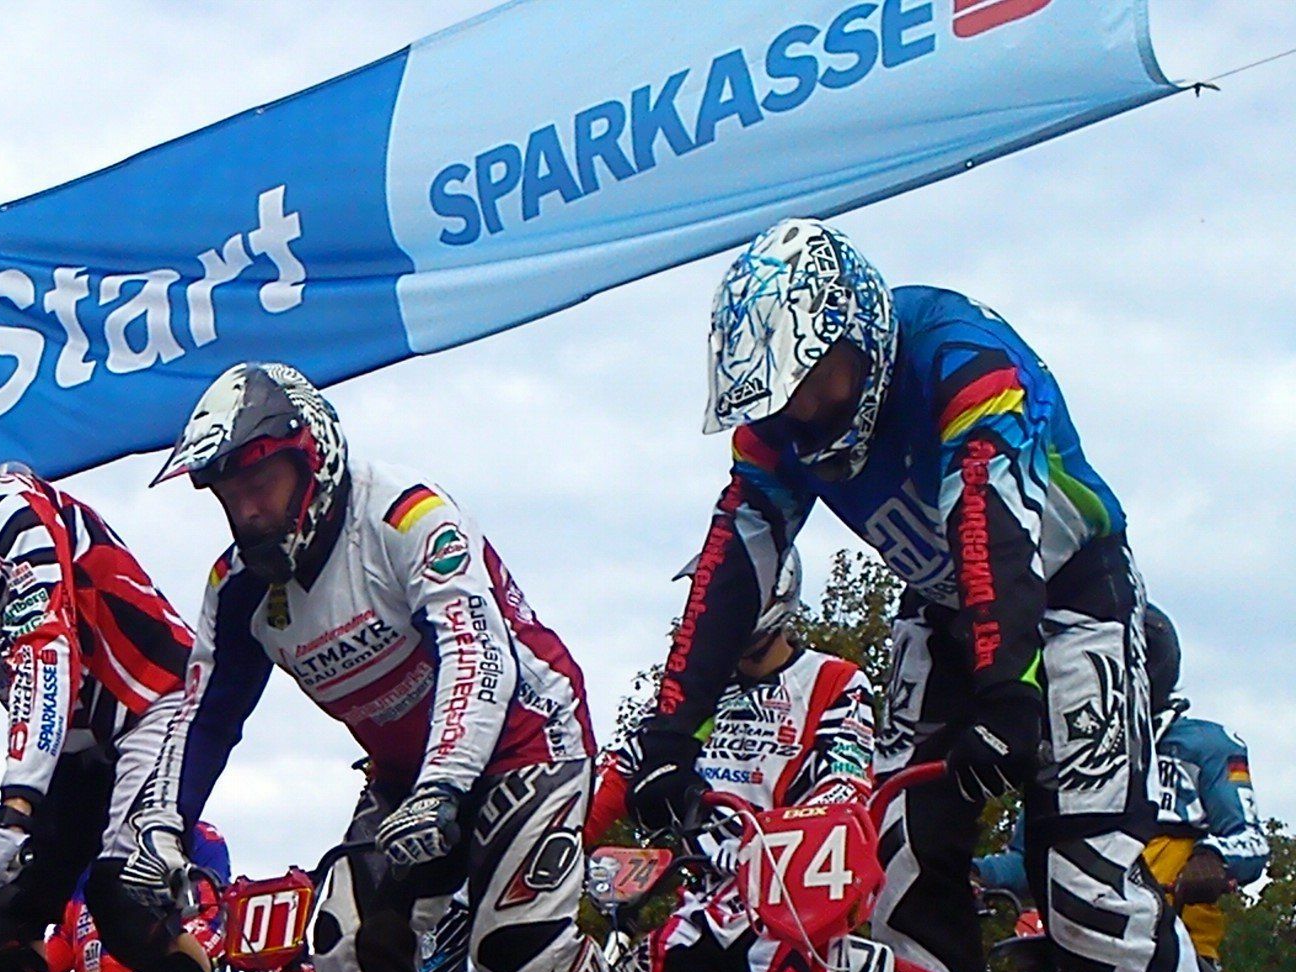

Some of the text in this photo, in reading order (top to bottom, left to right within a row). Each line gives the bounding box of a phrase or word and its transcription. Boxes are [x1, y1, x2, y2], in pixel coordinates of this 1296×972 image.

[431, 0, 938, 246] SPARKASSE
[293, 619, 392, 678] LTMAYR
[341, 630, 399, 670] GmbH
[38, 664, 58, 752] SPARKASSE
[783, 806, 828, 819] BOX
[737, 825, 853, 908] 174
